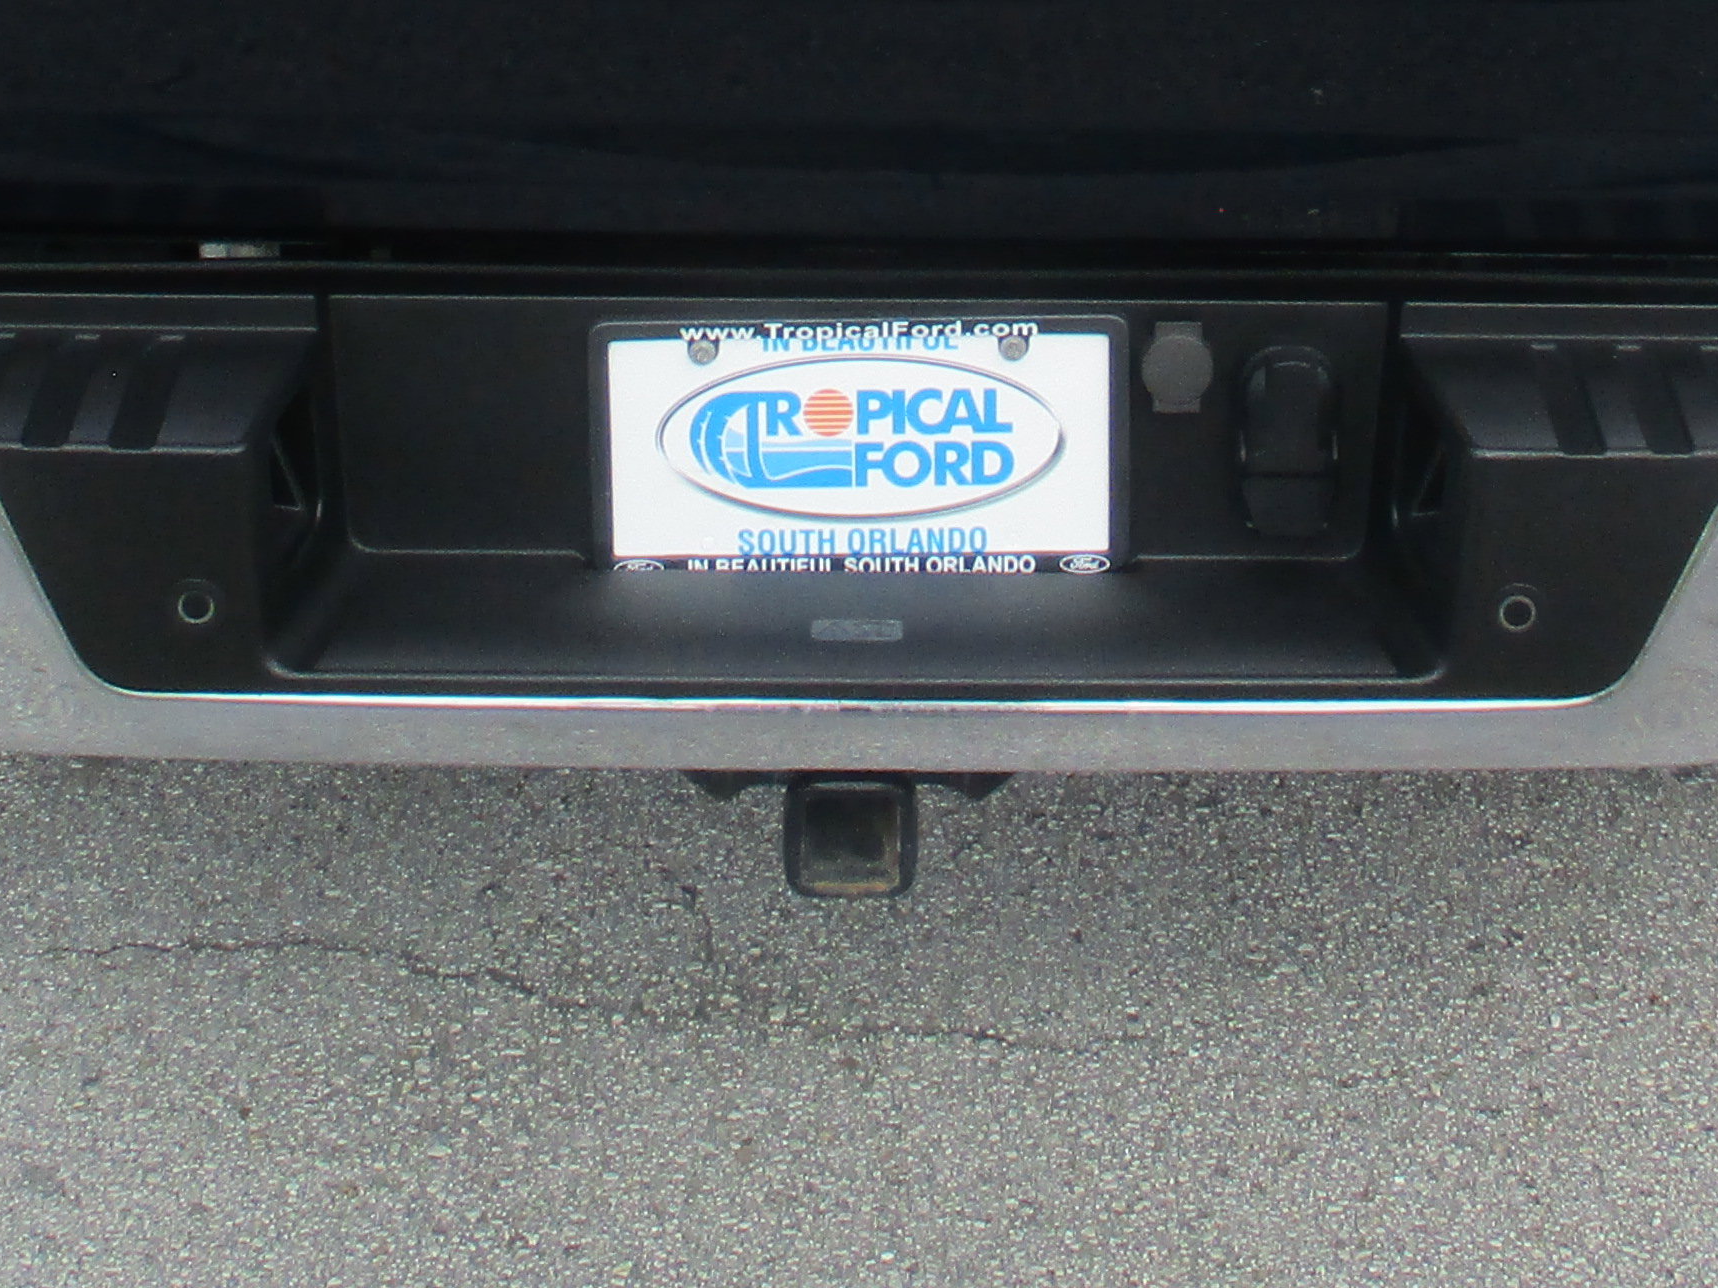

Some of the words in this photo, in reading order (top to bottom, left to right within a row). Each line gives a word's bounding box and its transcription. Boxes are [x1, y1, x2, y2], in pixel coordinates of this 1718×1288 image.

[679, 319, 1040, 342] www.TropicalFord.com
[690, 388, 1014, 440] TROPICAL
[854, 441, 1015, 488] FORD
[736, 527, 836, 556] SOUTH
[847, 526, 988, 555] ORLANDO
[687, 557, 709, 571] IN
[843, 556, 924, 573] SOUTH
[925, 555, 1036, 573] ORLANDO
